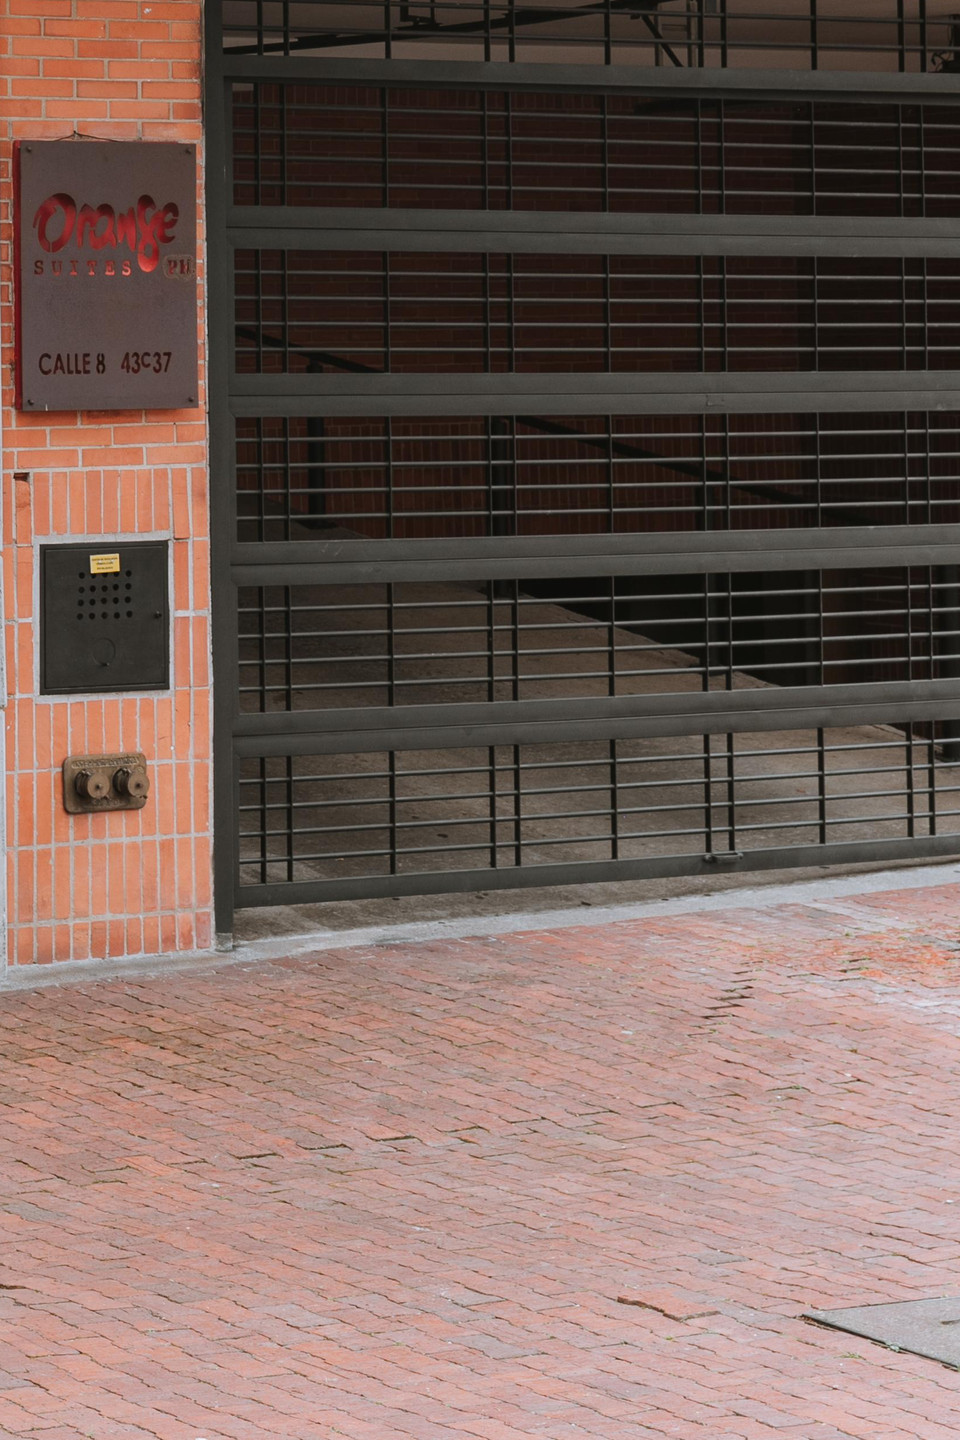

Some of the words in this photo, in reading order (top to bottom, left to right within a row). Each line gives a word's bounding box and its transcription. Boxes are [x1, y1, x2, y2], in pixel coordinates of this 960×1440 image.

[32, 192, 179, 273] Orange
[33, 260, 132, 276] SUITES
[38, 352, 91, 375] CALLE
[96, 352, 106, 374] 8
